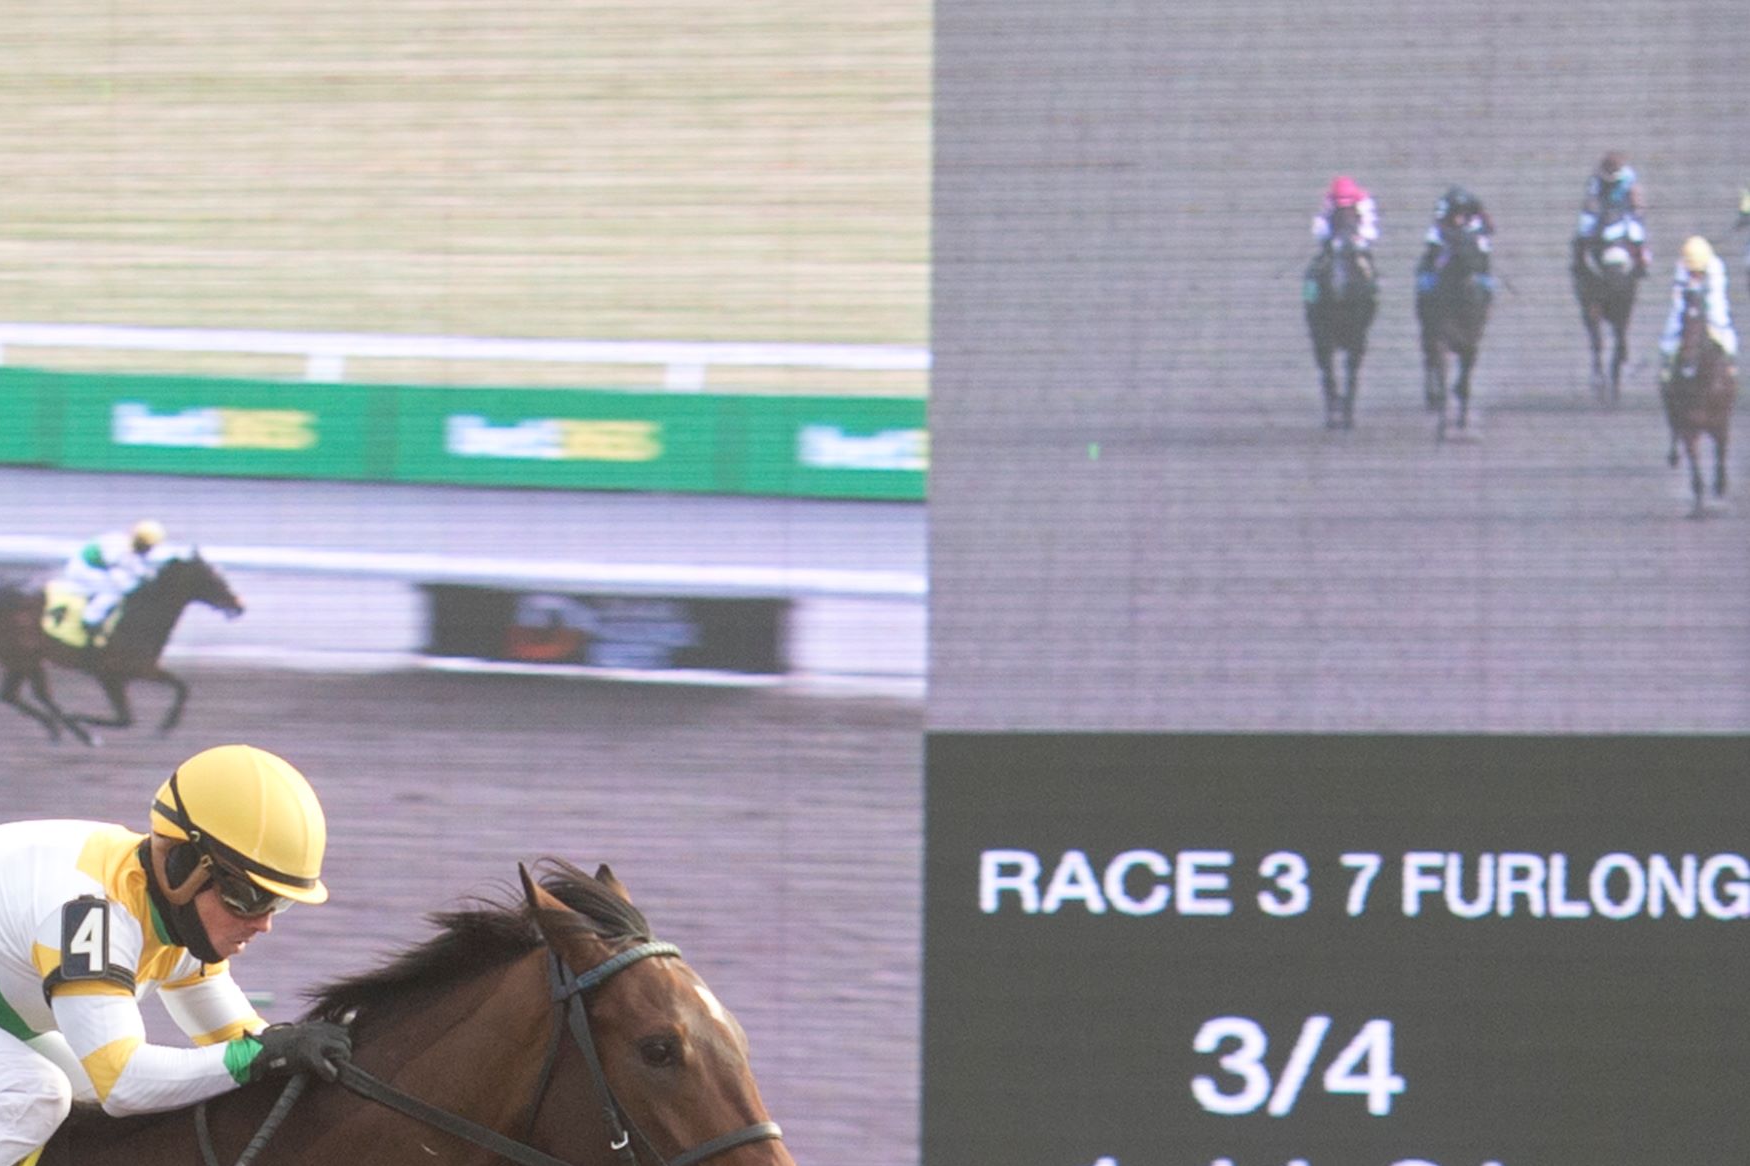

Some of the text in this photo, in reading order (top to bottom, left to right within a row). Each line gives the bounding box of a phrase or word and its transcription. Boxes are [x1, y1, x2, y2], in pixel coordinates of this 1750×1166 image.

[978, 849, 1234, 915] RACE
[1256, 851, 1312, 917] 3
[1340, 853, 1382, 917] 7
[68, 906, 106, 973] 4
[1190, 1014, 1408, 1117] 3/4
